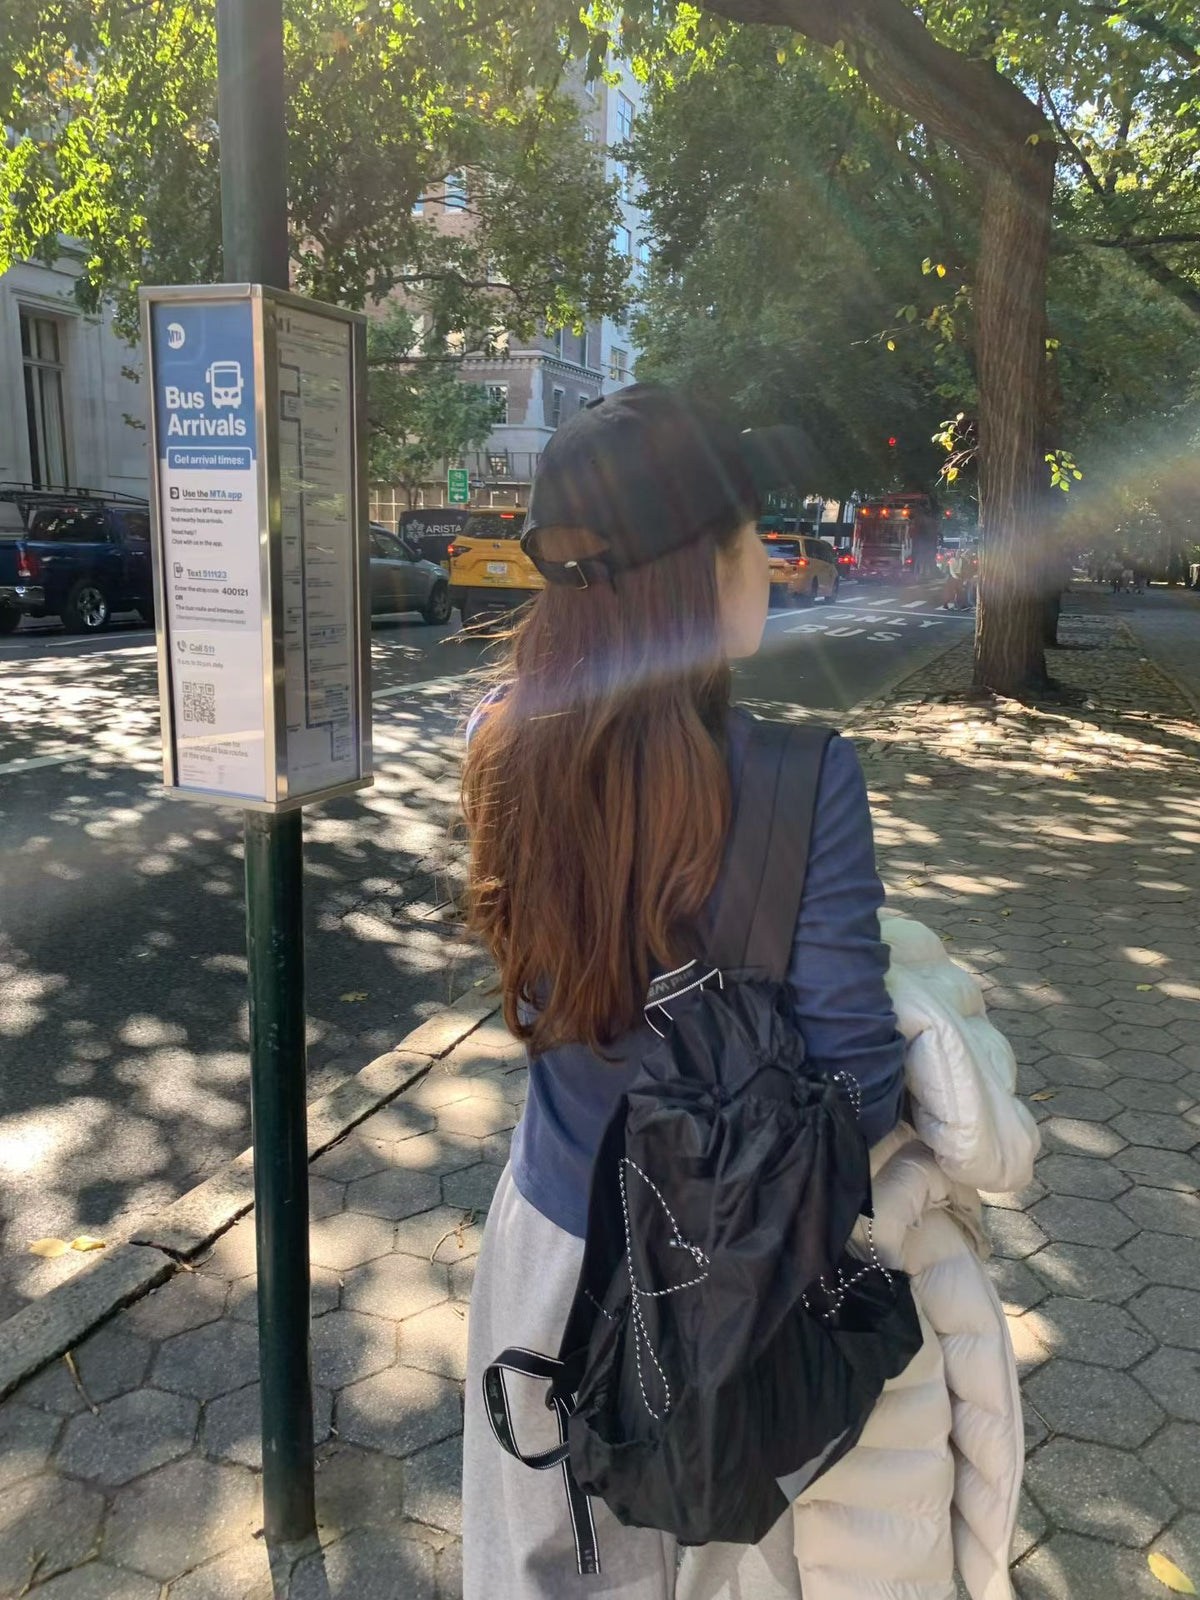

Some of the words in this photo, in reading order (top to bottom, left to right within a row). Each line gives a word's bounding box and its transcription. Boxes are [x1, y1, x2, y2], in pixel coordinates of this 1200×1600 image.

[165, 386, 205, 409] Bus
[168, 413, 246, 436] Arrivals
[174, 454, 189, 464] Get
[190, 455, 217, 464] arrival
[218, 455, 244, 465] times:
[210, 490, 226, 498] MTA
[228, 492, 242, 500] app
[426, 525, 462, 533] ARISTA
[187, 569, 201, 577] Text
[203, 570, 227, 578] 511123
[222, 588, 248, 597] 400121
[824, 614, 944, 628] ONLY
[783, 624, 902, 642] BUS
[190, 643, 202, 652] Call
[204, 645, 215, 653] 511
